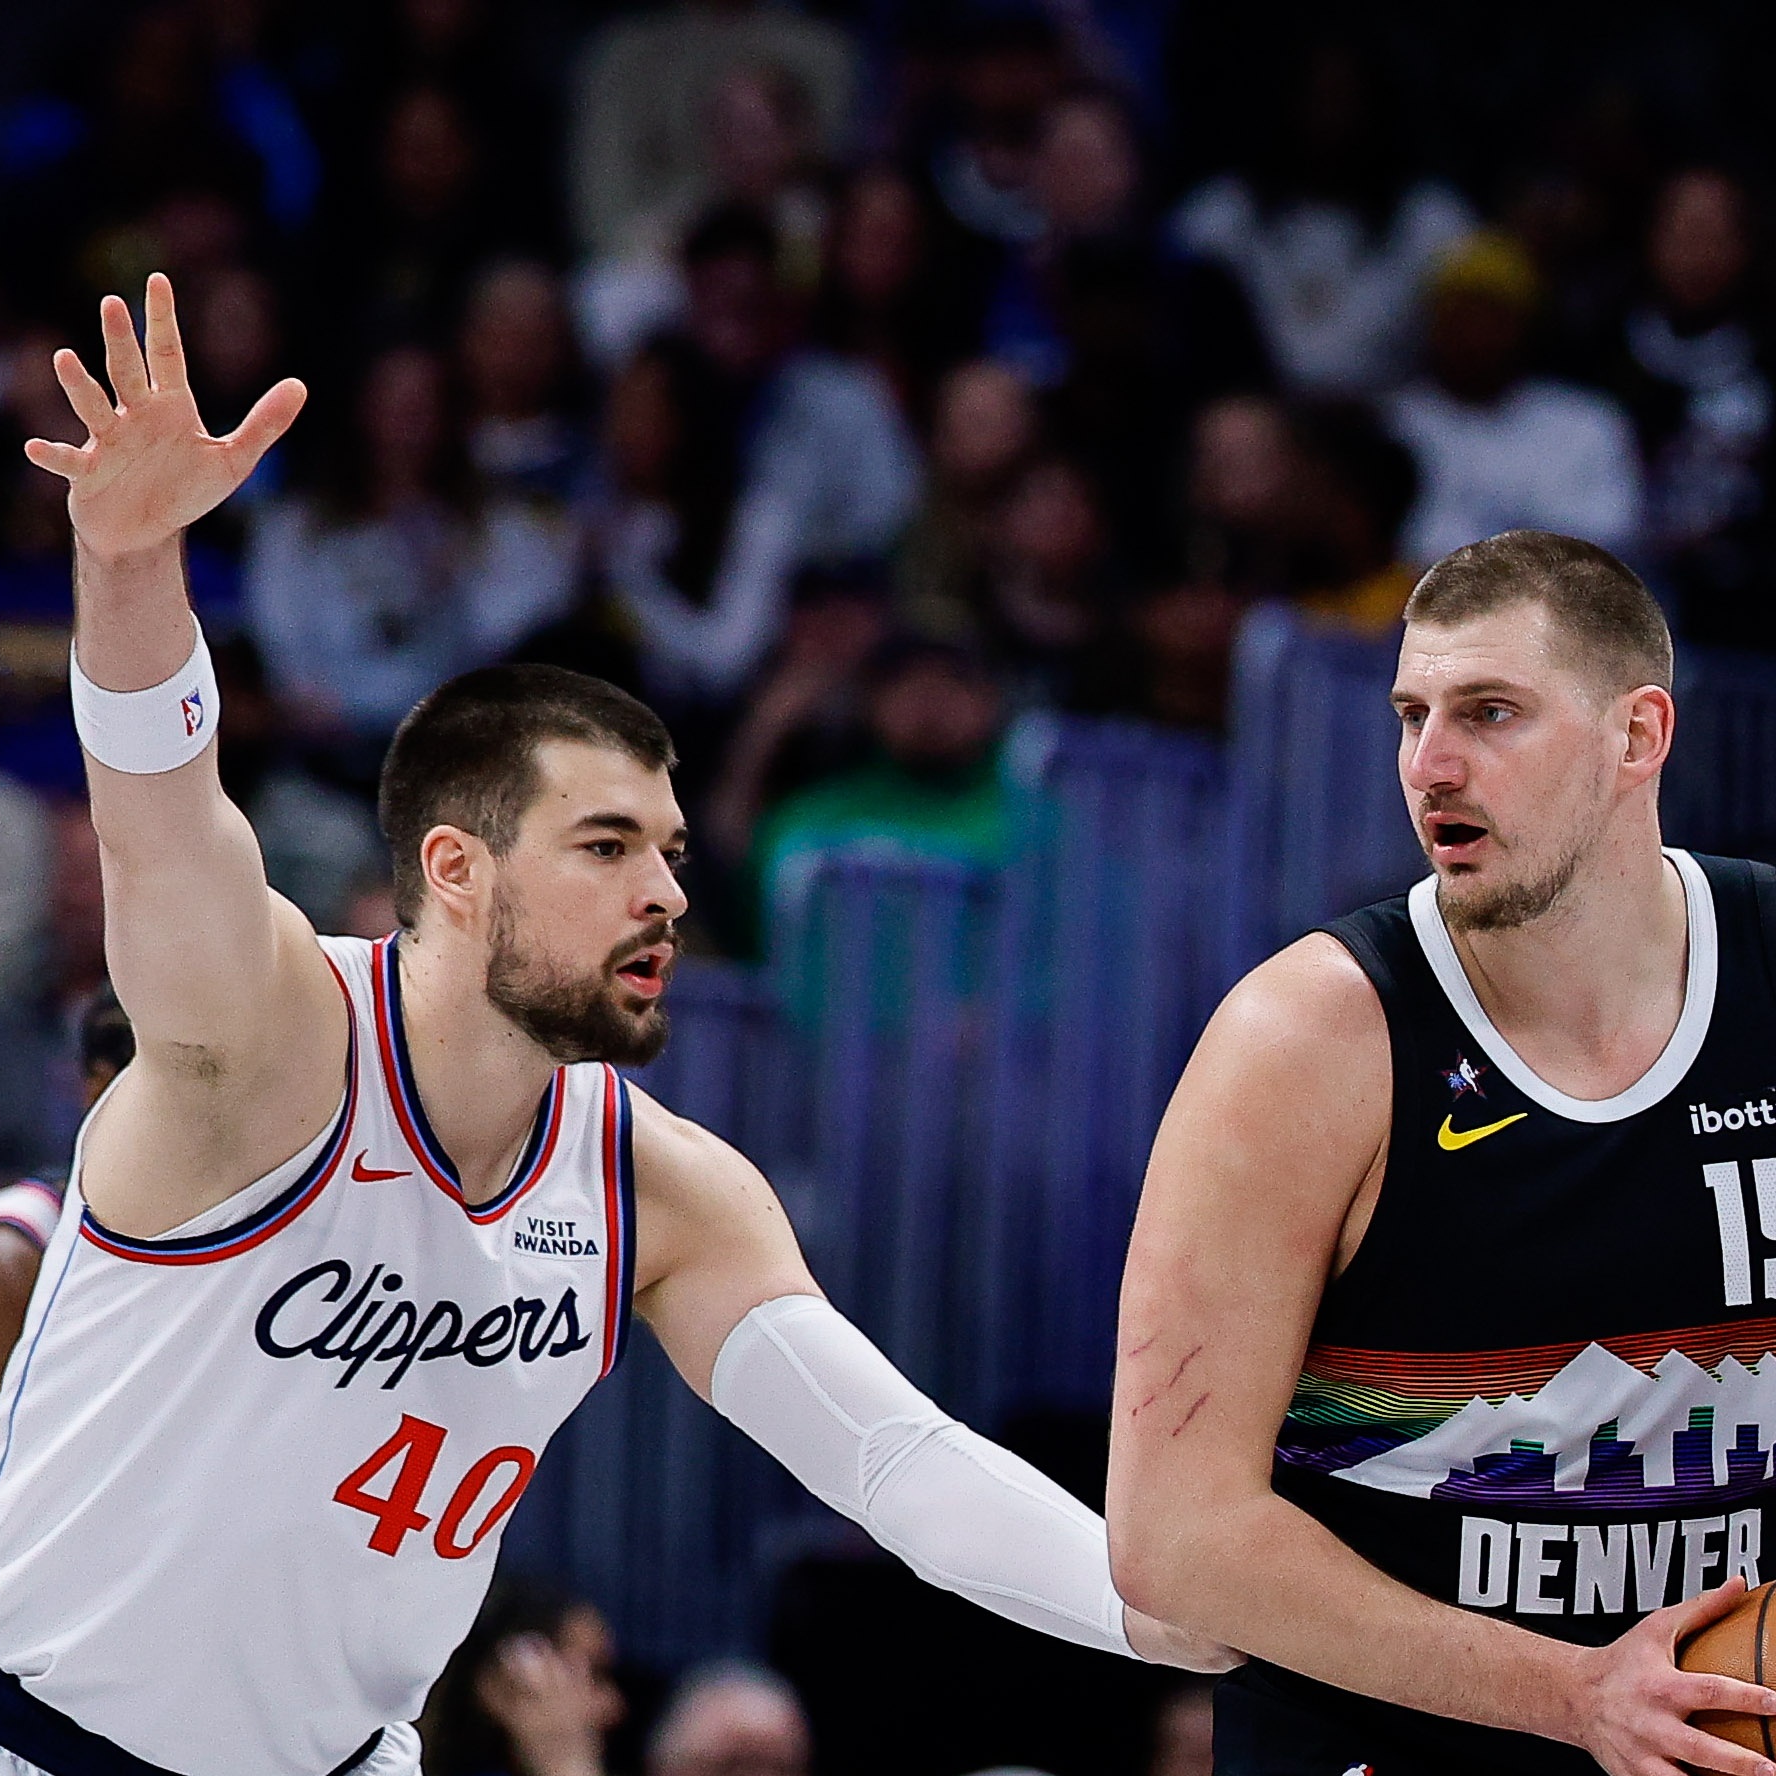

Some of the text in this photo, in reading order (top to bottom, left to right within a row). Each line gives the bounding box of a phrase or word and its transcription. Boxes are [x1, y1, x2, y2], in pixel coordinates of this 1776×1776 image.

[514, 1231, 599, 1256] RWANDA
[527, 1216, 576, 1237] VISIT
[255, 1259, 593, 1390] Clippers
[332, 1413, 536, 1559] 40
[1458, 1508, 1761, 1614] DENVER
